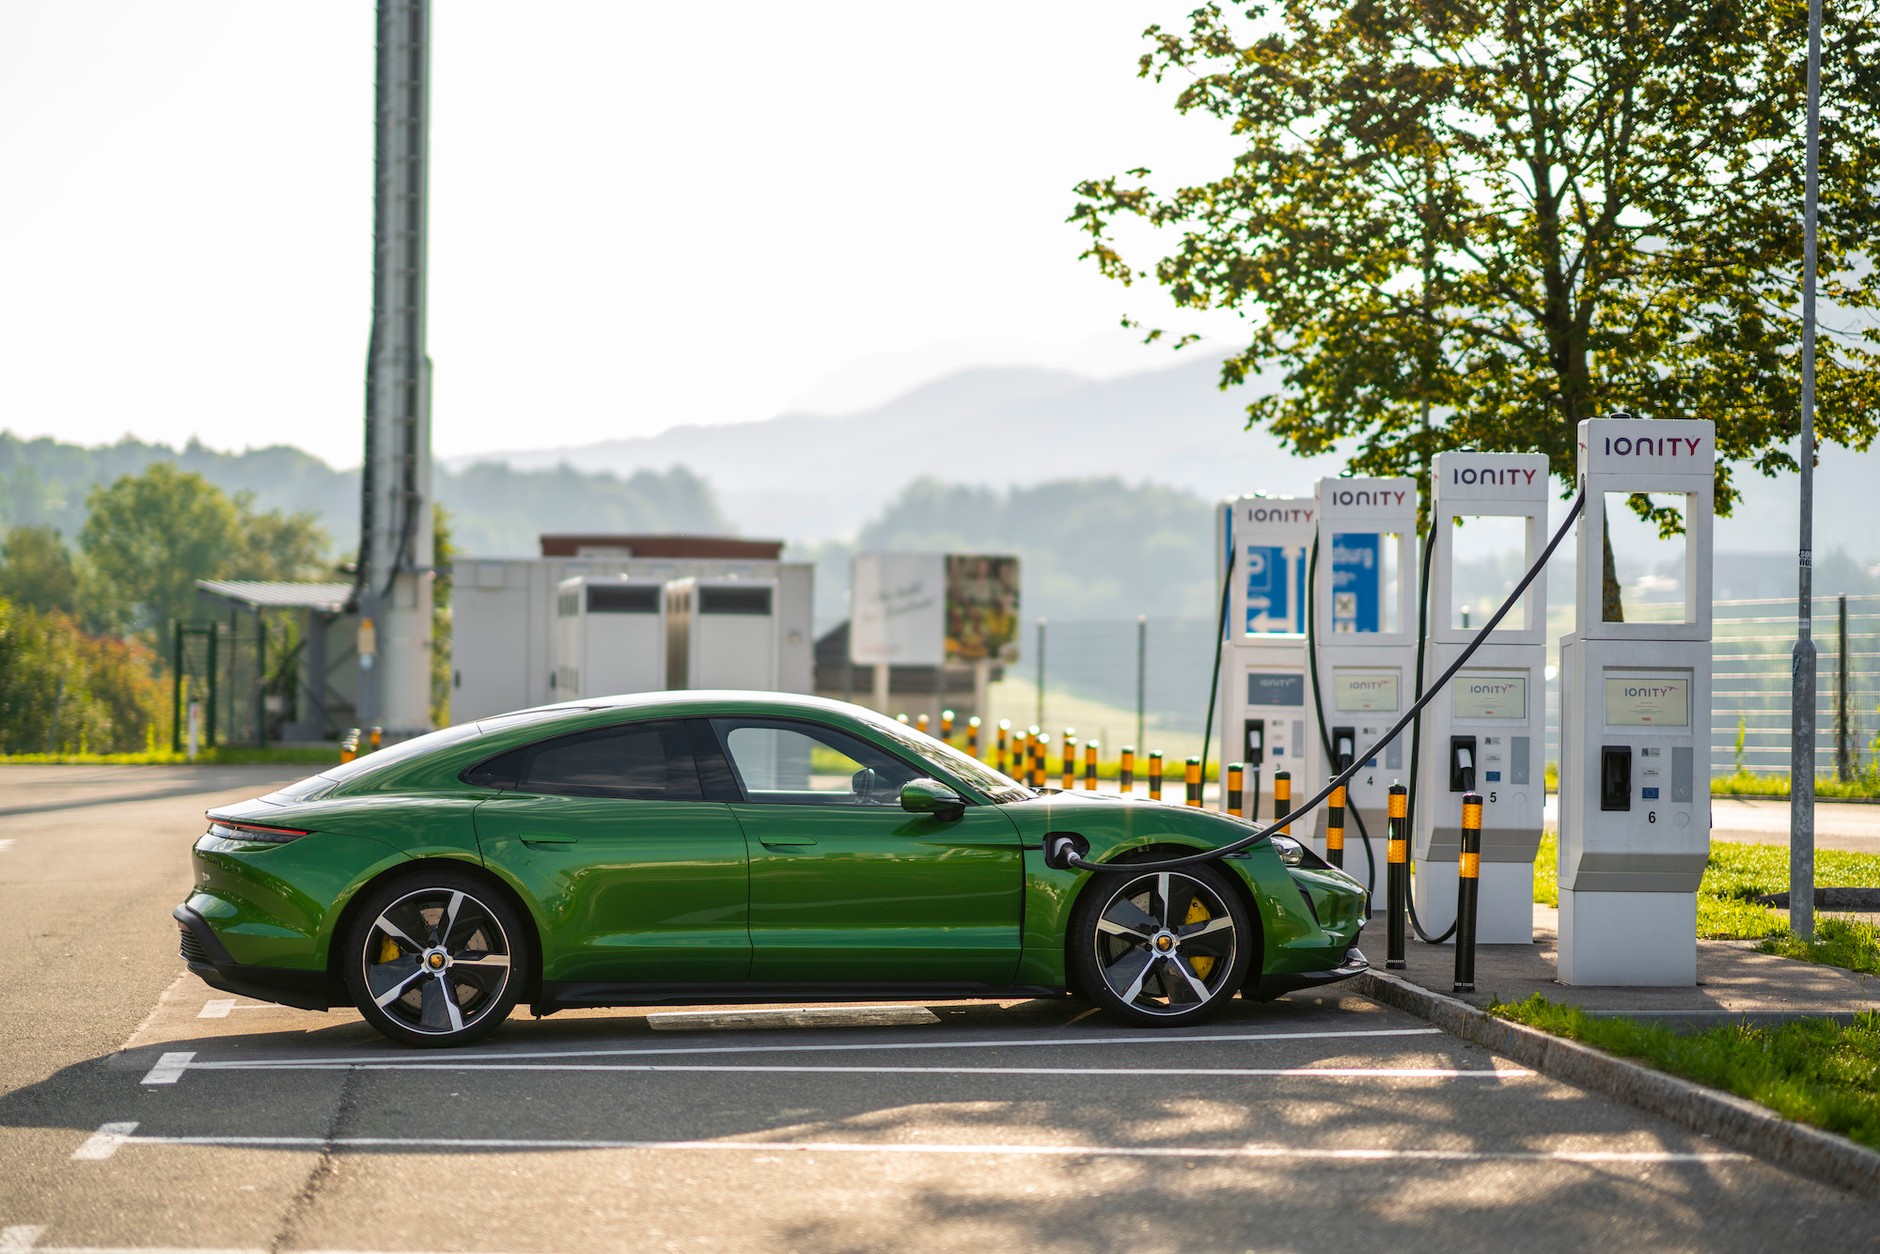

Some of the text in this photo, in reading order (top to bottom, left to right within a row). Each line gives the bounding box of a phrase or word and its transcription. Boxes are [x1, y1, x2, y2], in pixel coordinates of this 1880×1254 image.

[1605, 437, 1701, 456] IONITY
[1454, 468, 1537, 485] IONITY
[1332, 491, 1406, 506] IONITY
[1248, 509, 1314, 523] IONITY
[1349, 681, 1383, 690] IONITY
[1470, 685, 1508, 694] IONITY
[1624, 687, 1668, 697] IONITY
[1367, 776, 1373, 786] 4
[1490, 792, 1497, 803] 5
[1648, 811, 1656, 824] 6
